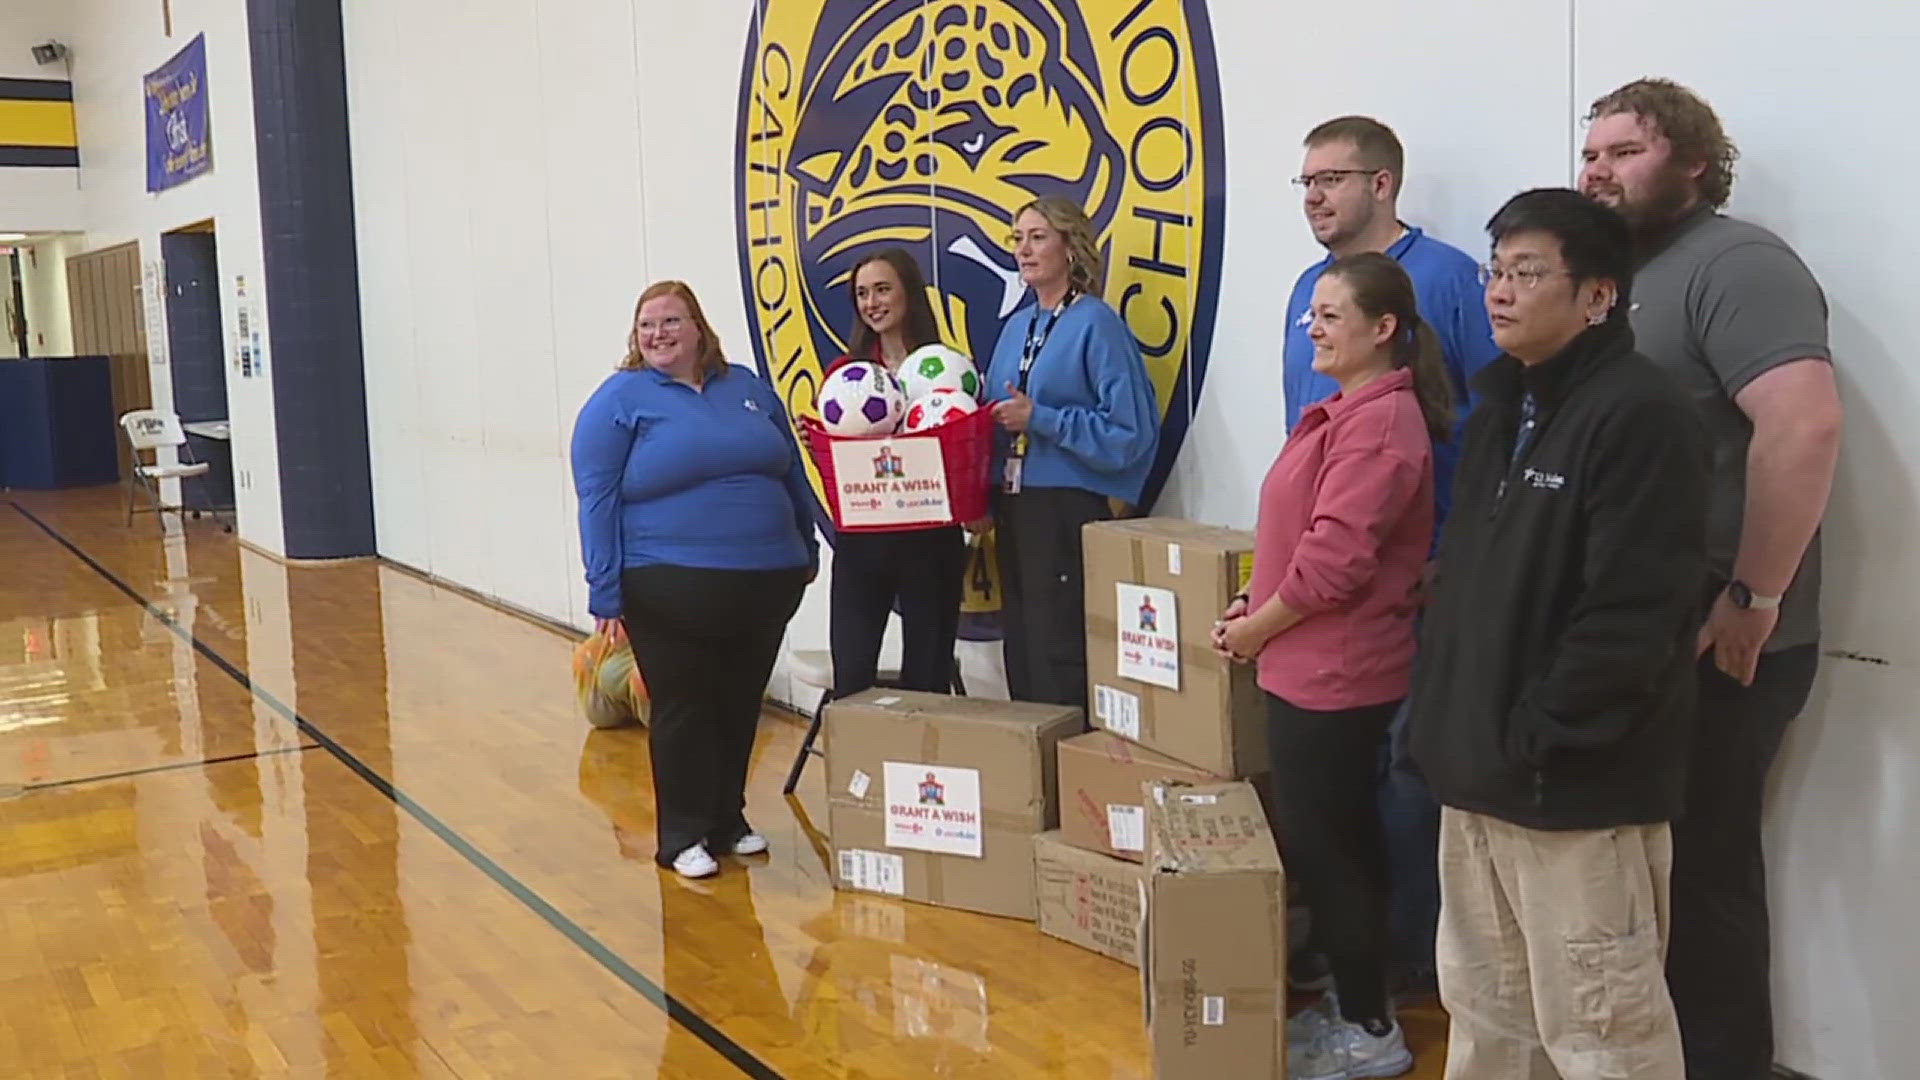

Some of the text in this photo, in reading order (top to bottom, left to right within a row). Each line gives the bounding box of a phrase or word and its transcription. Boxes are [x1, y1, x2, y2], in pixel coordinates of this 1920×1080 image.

[1109, 0, 1194, 358] CHOO
[748, 42, 818, 427] CATHOLIC
[843, 479, 941, 495] GRANT A WISH
[972, 547, 992, 601] 4
[1121, 630, 1146, 646] GRANT
[1147, 636, 1154, 648] A
[890, 804, 976, 824] GRANT A WISH
